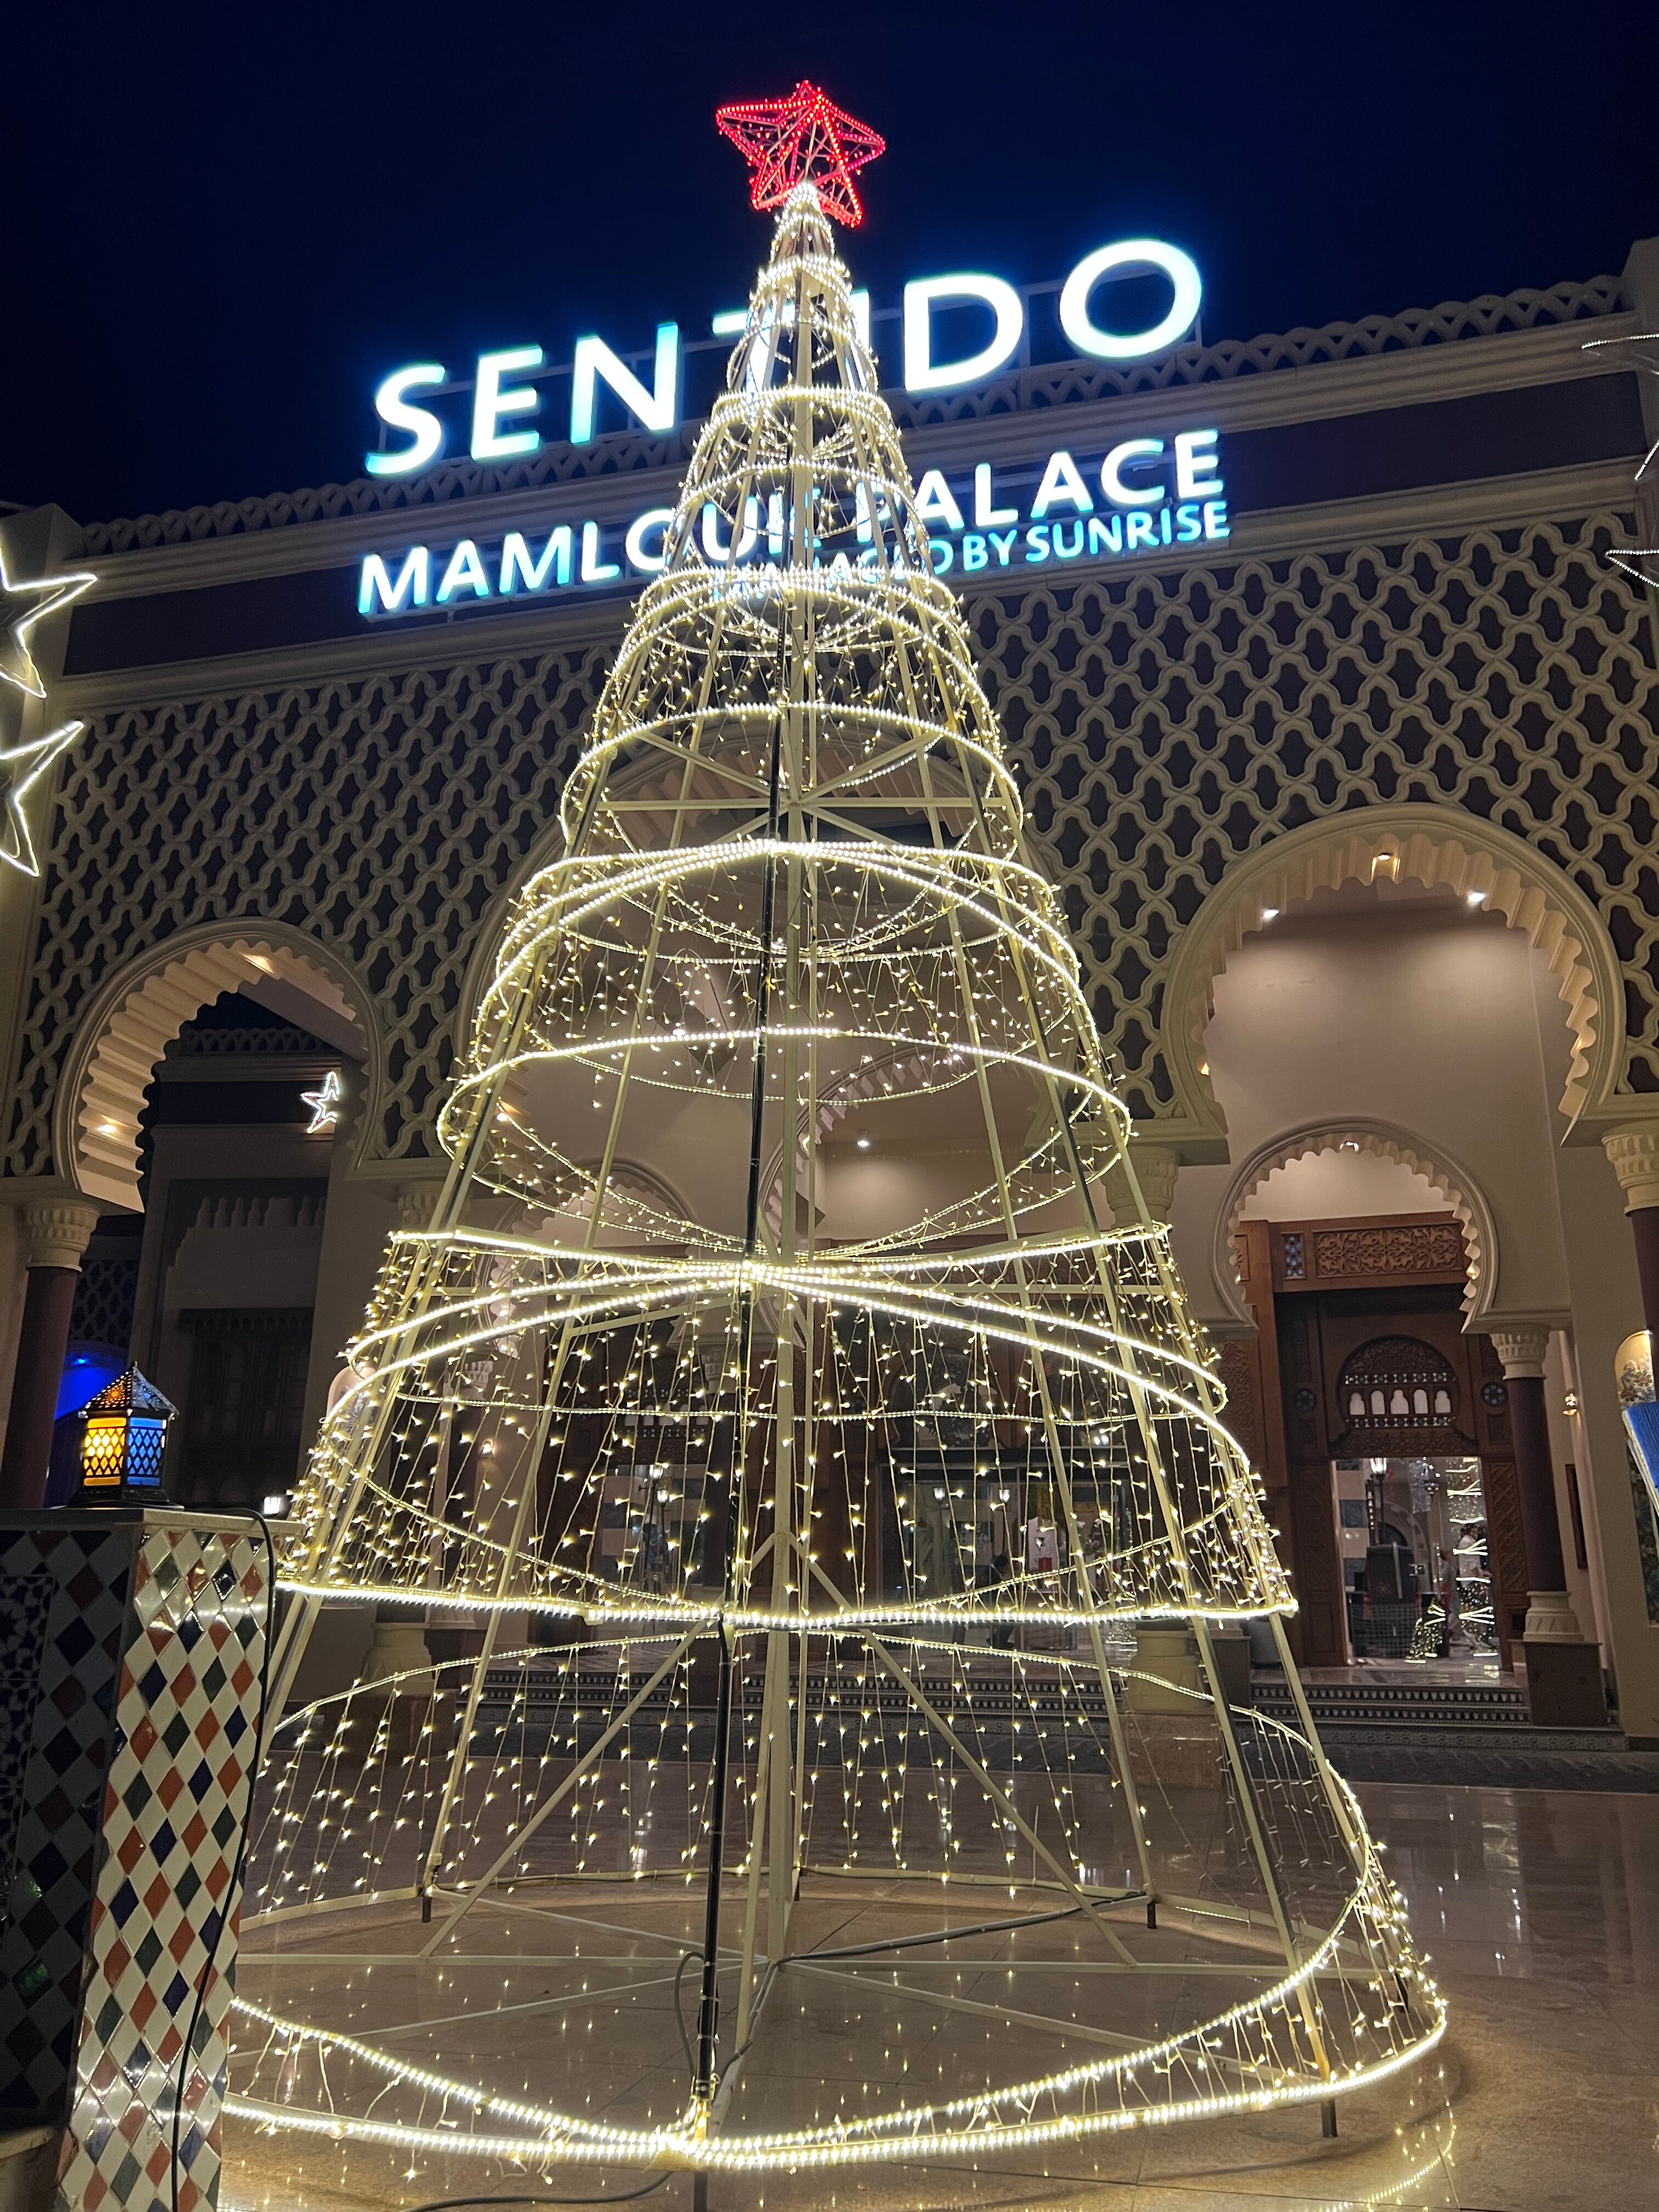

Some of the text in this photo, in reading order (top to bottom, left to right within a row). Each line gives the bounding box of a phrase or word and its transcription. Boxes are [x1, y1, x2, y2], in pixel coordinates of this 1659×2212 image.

[856, 430, 1224, 543] PALACE
[962, 529, 1017, 571] BY
[1025, 500, 1231, 563] SUNRISE
